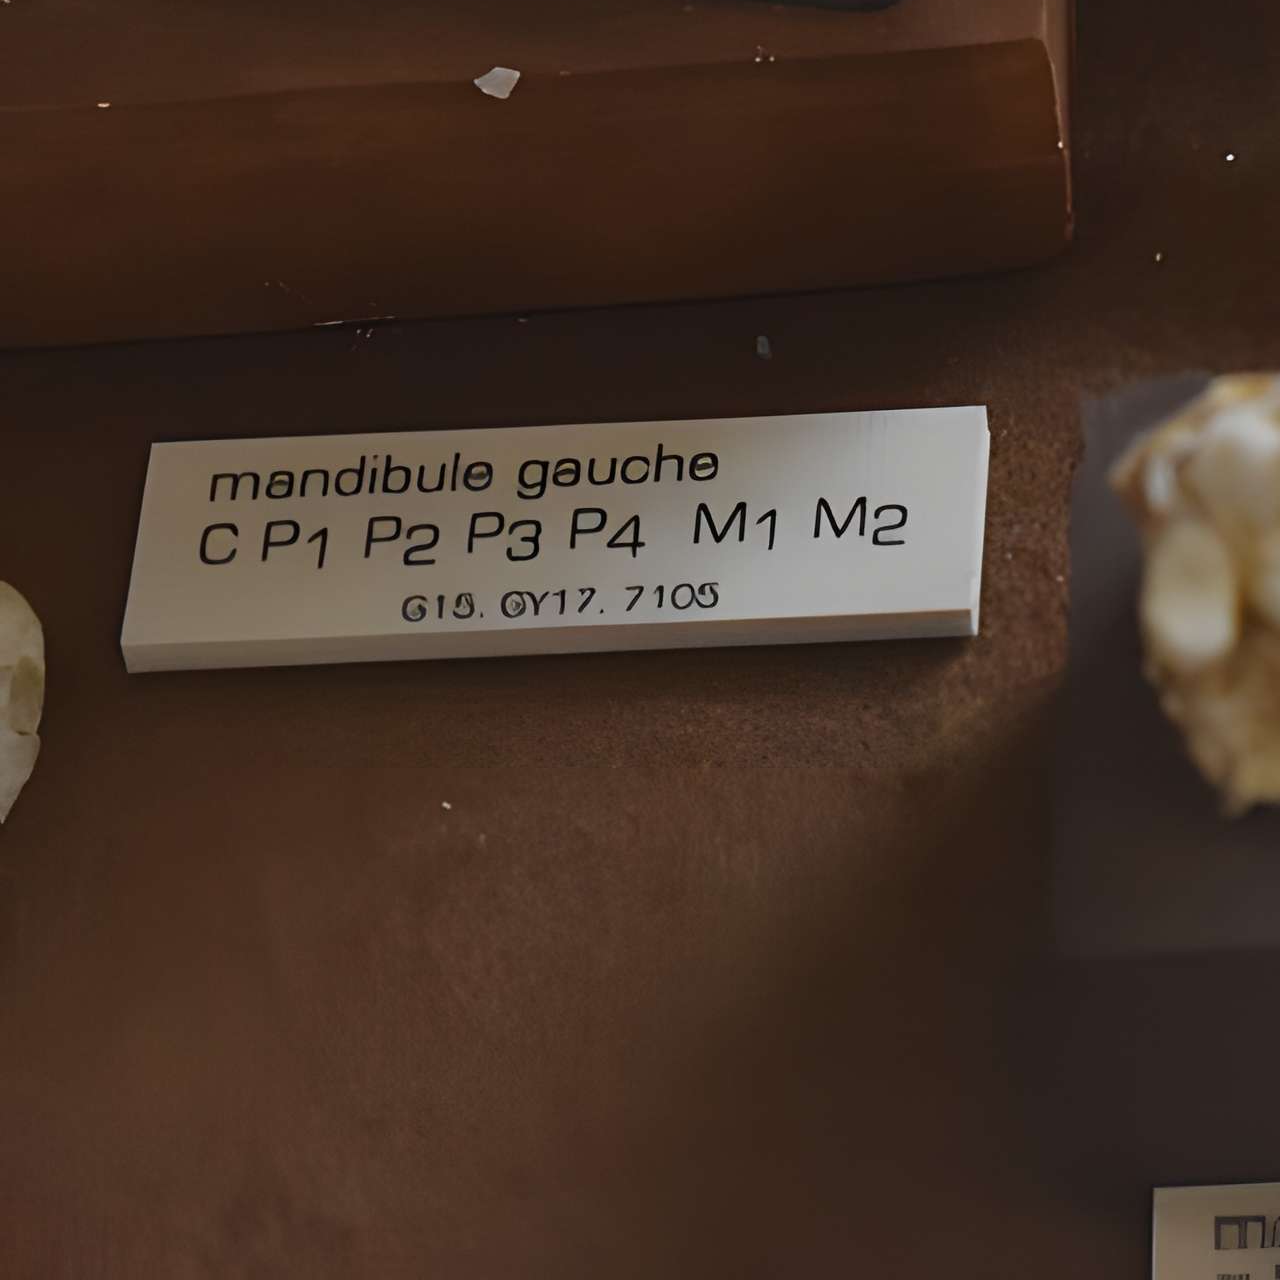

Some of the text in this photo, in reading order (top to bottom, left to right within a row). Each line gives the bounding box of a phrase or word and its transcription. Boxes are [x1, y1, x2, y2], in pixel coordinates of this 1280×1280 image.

[208, 444, 719, 504] mandibule gauche
[198, 496, 909, 570] C P1 P2 P3 P4 M1 M2
[624, 582, 720, 612] 7105
